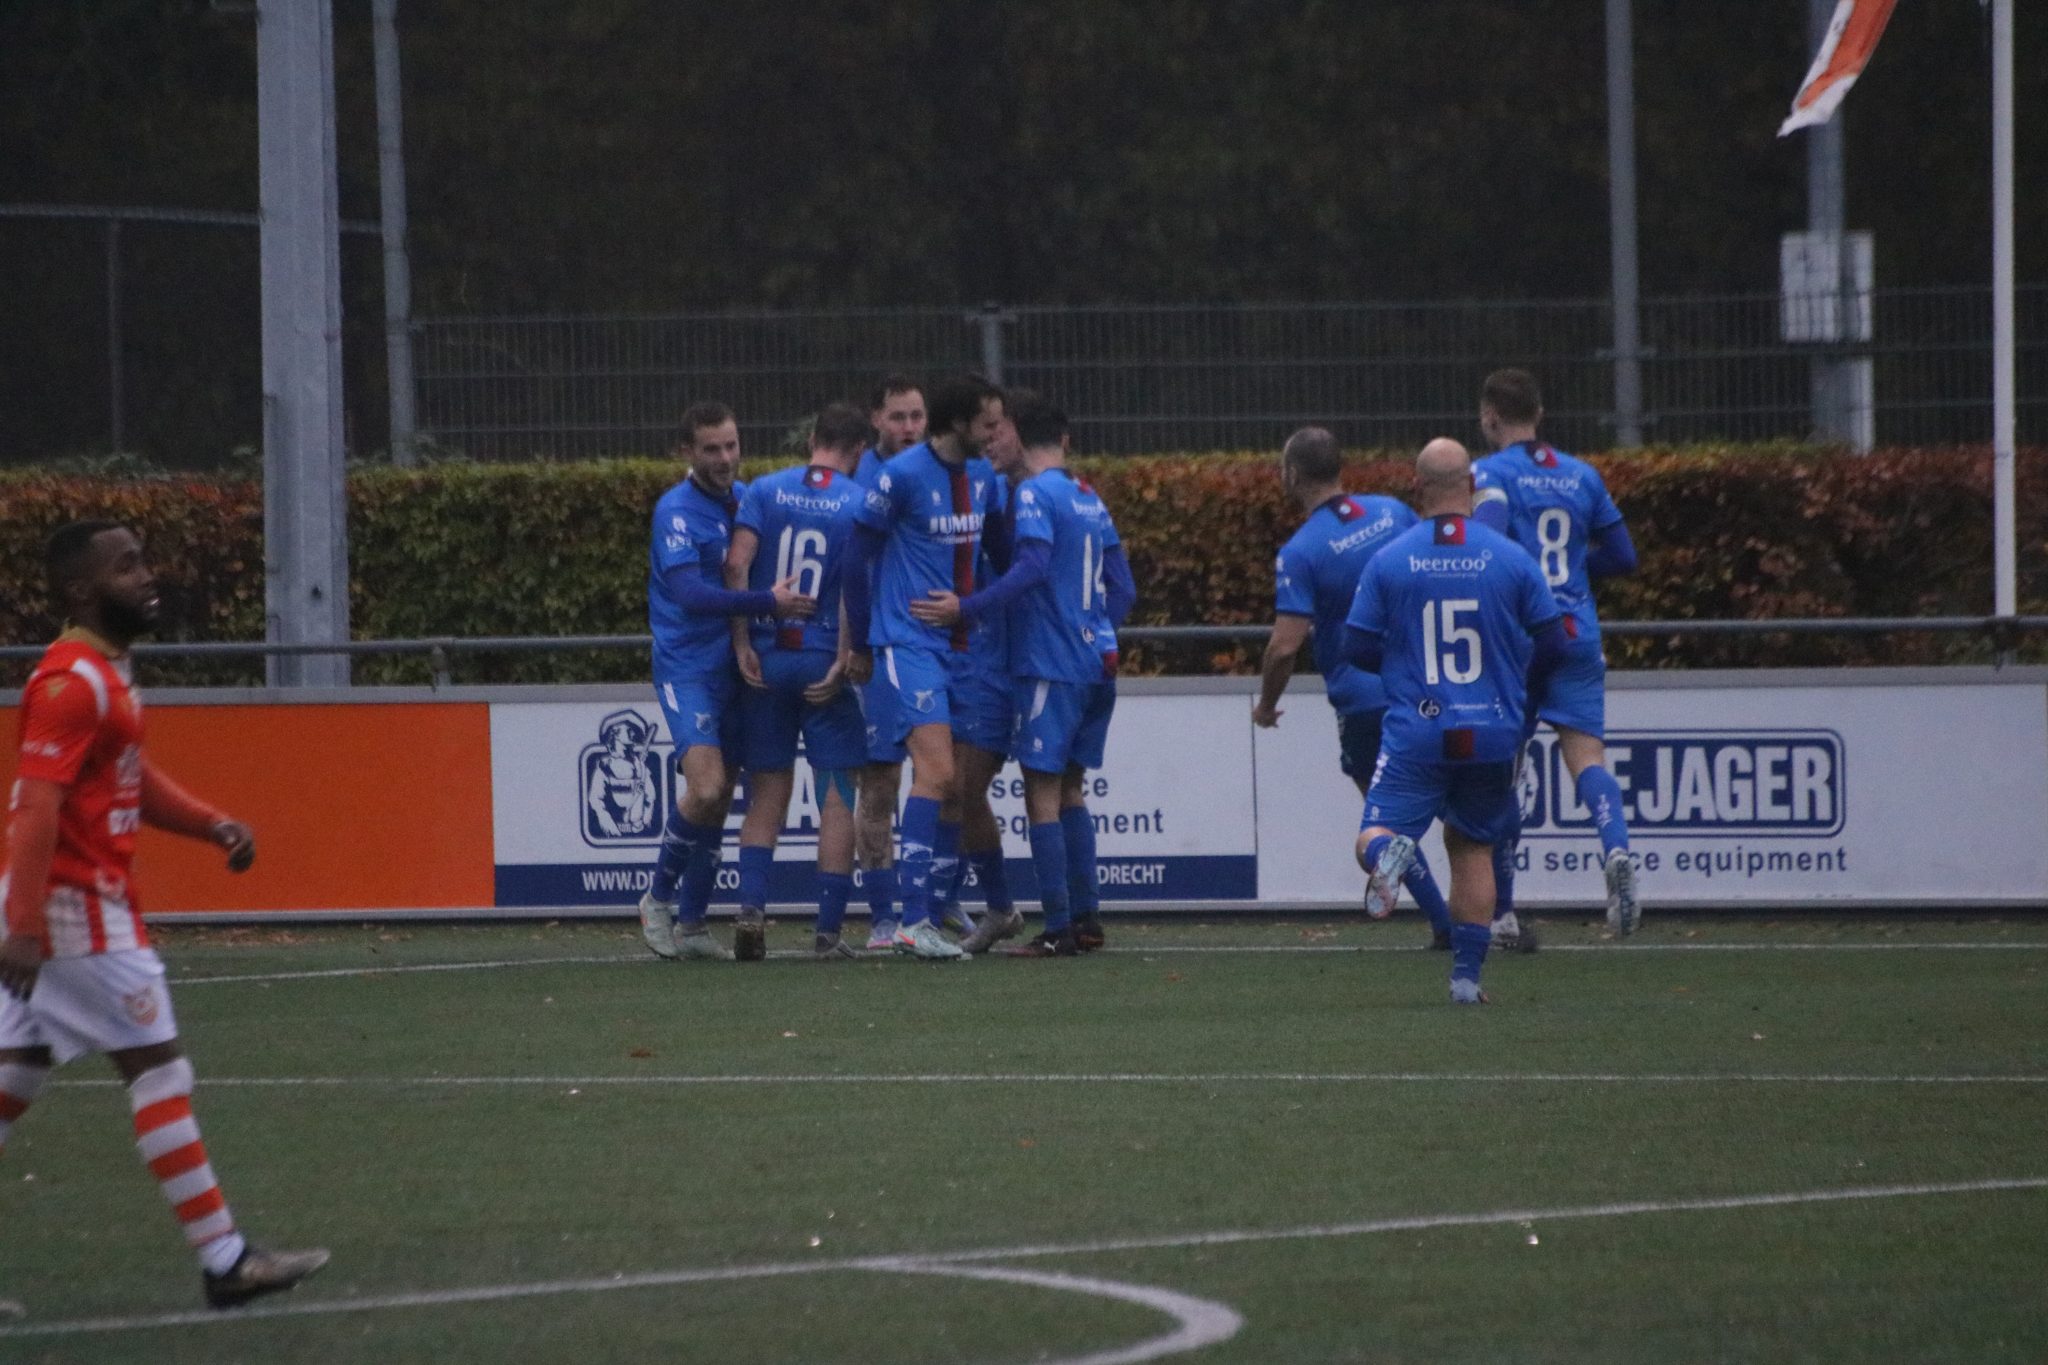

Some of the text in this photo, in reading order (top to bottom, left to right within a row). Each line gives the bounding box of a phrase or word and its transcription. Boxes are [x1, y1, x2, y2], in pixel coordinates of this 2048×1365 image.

[776, 525, 827, 600] 16
[1408, 553, 1487, 573] beercoo
[1538, 508, 1571, 586] 8
[1422, 599, 1483, 685] 15
[1544, 850, 1660, 872] servce
[1675, 846, 1847, 878] equipment
